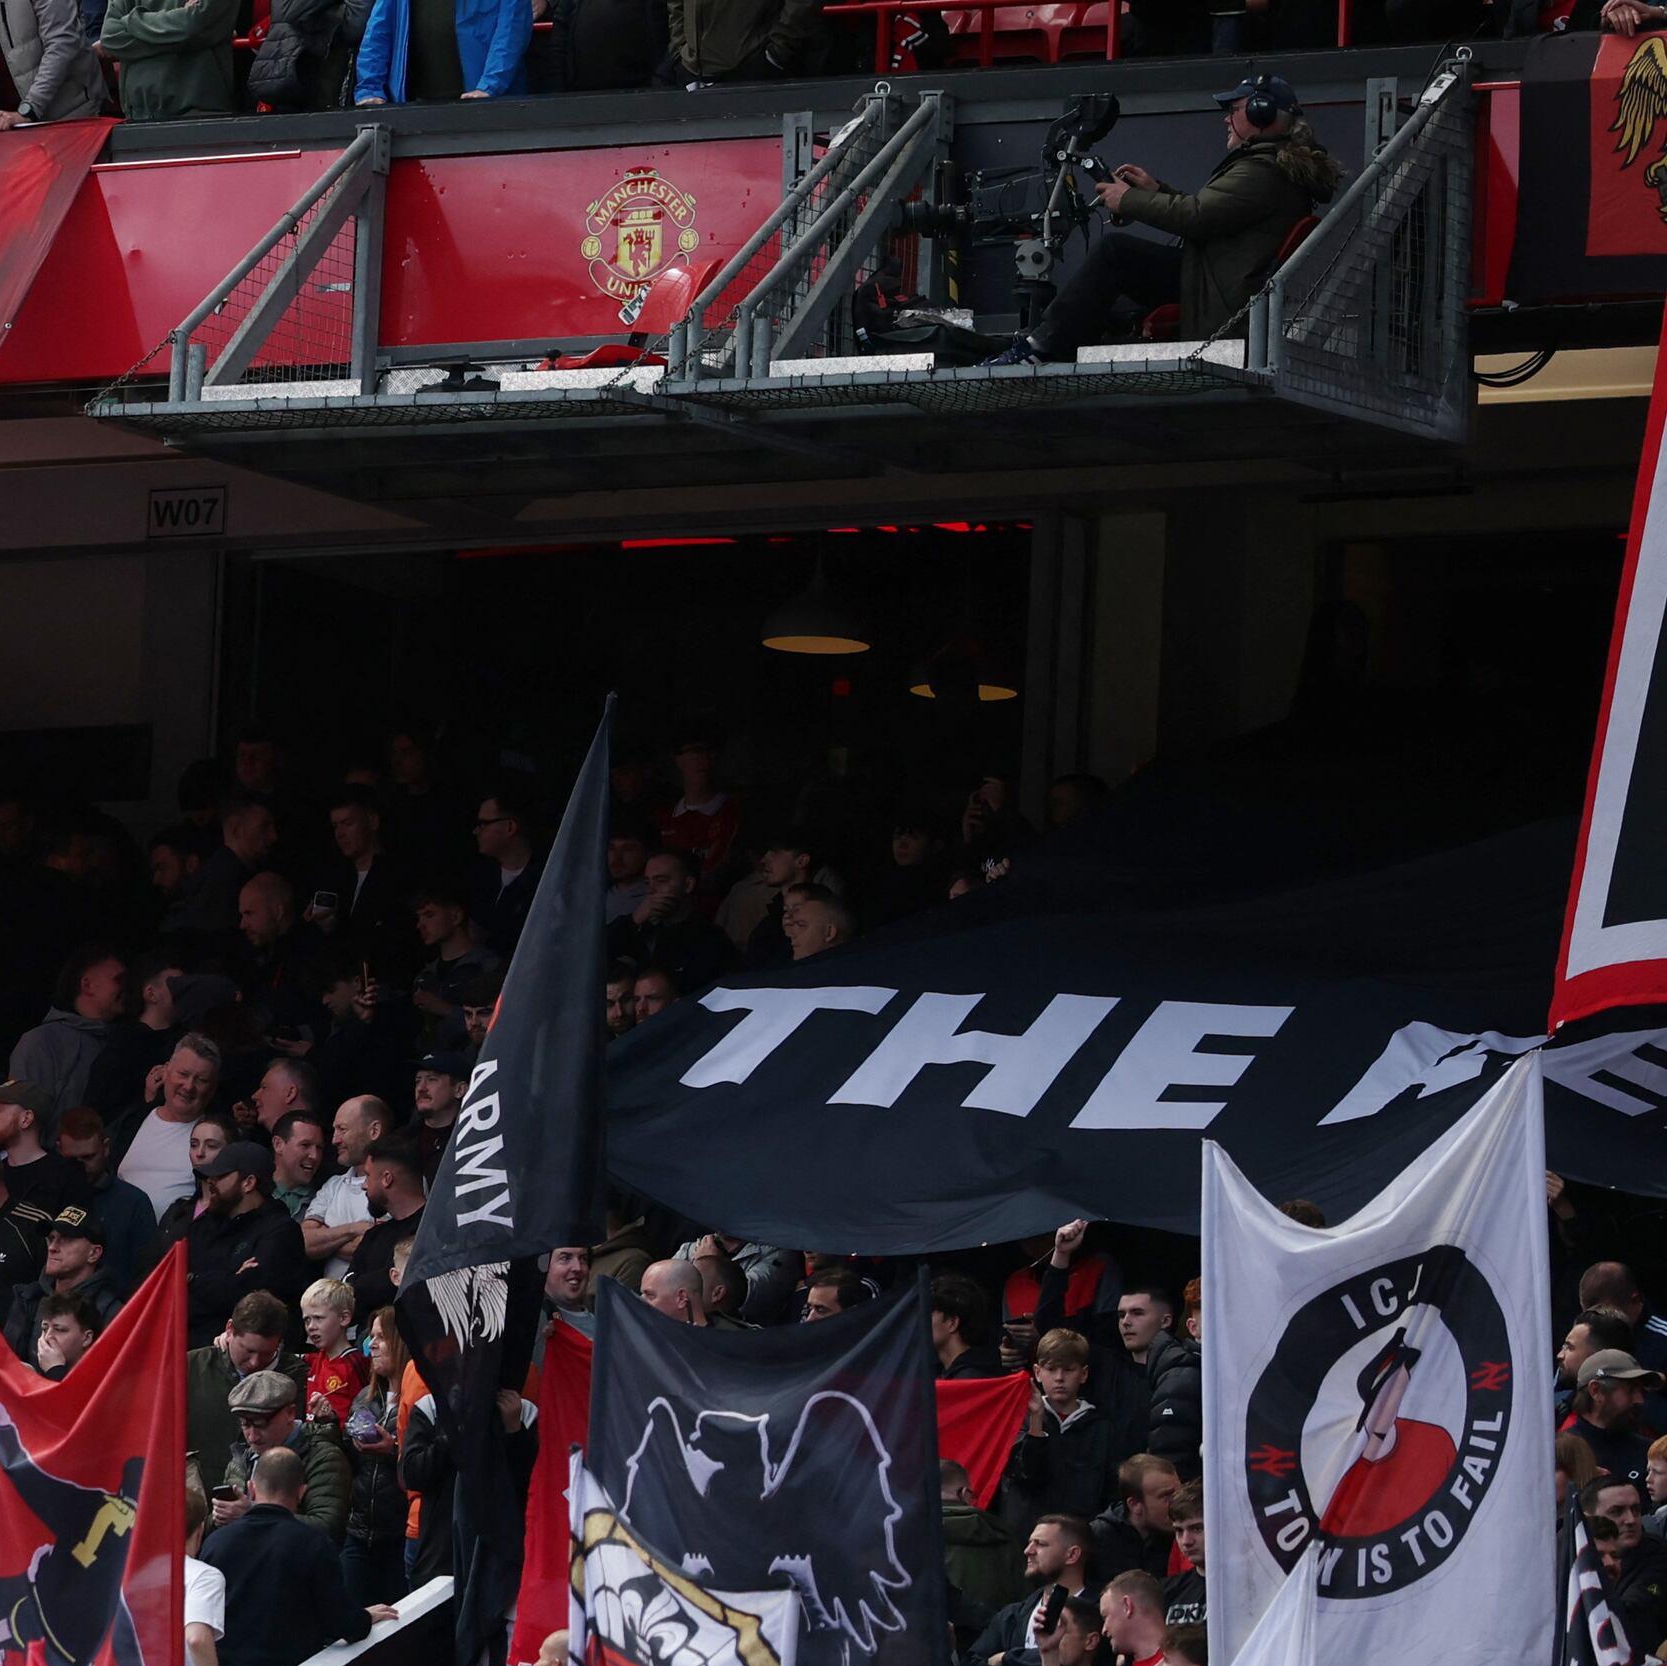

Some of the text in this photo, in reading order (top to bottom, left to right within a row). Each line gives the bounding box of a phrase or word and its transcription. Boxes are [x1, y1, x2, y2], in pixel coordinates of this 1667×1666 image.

[592, 177, 690, 228] MANCHESTER
[153, 498, 219, 528] W07
[679, 986, 1296, 1129] THE
[455, 1057, 515, 1229] ARMY
[1355, 1543, 1393, 1587] IS
[1399, 1509, 1455, 1568] TO
[1451, 1409, 1505, 1512] FAIL
